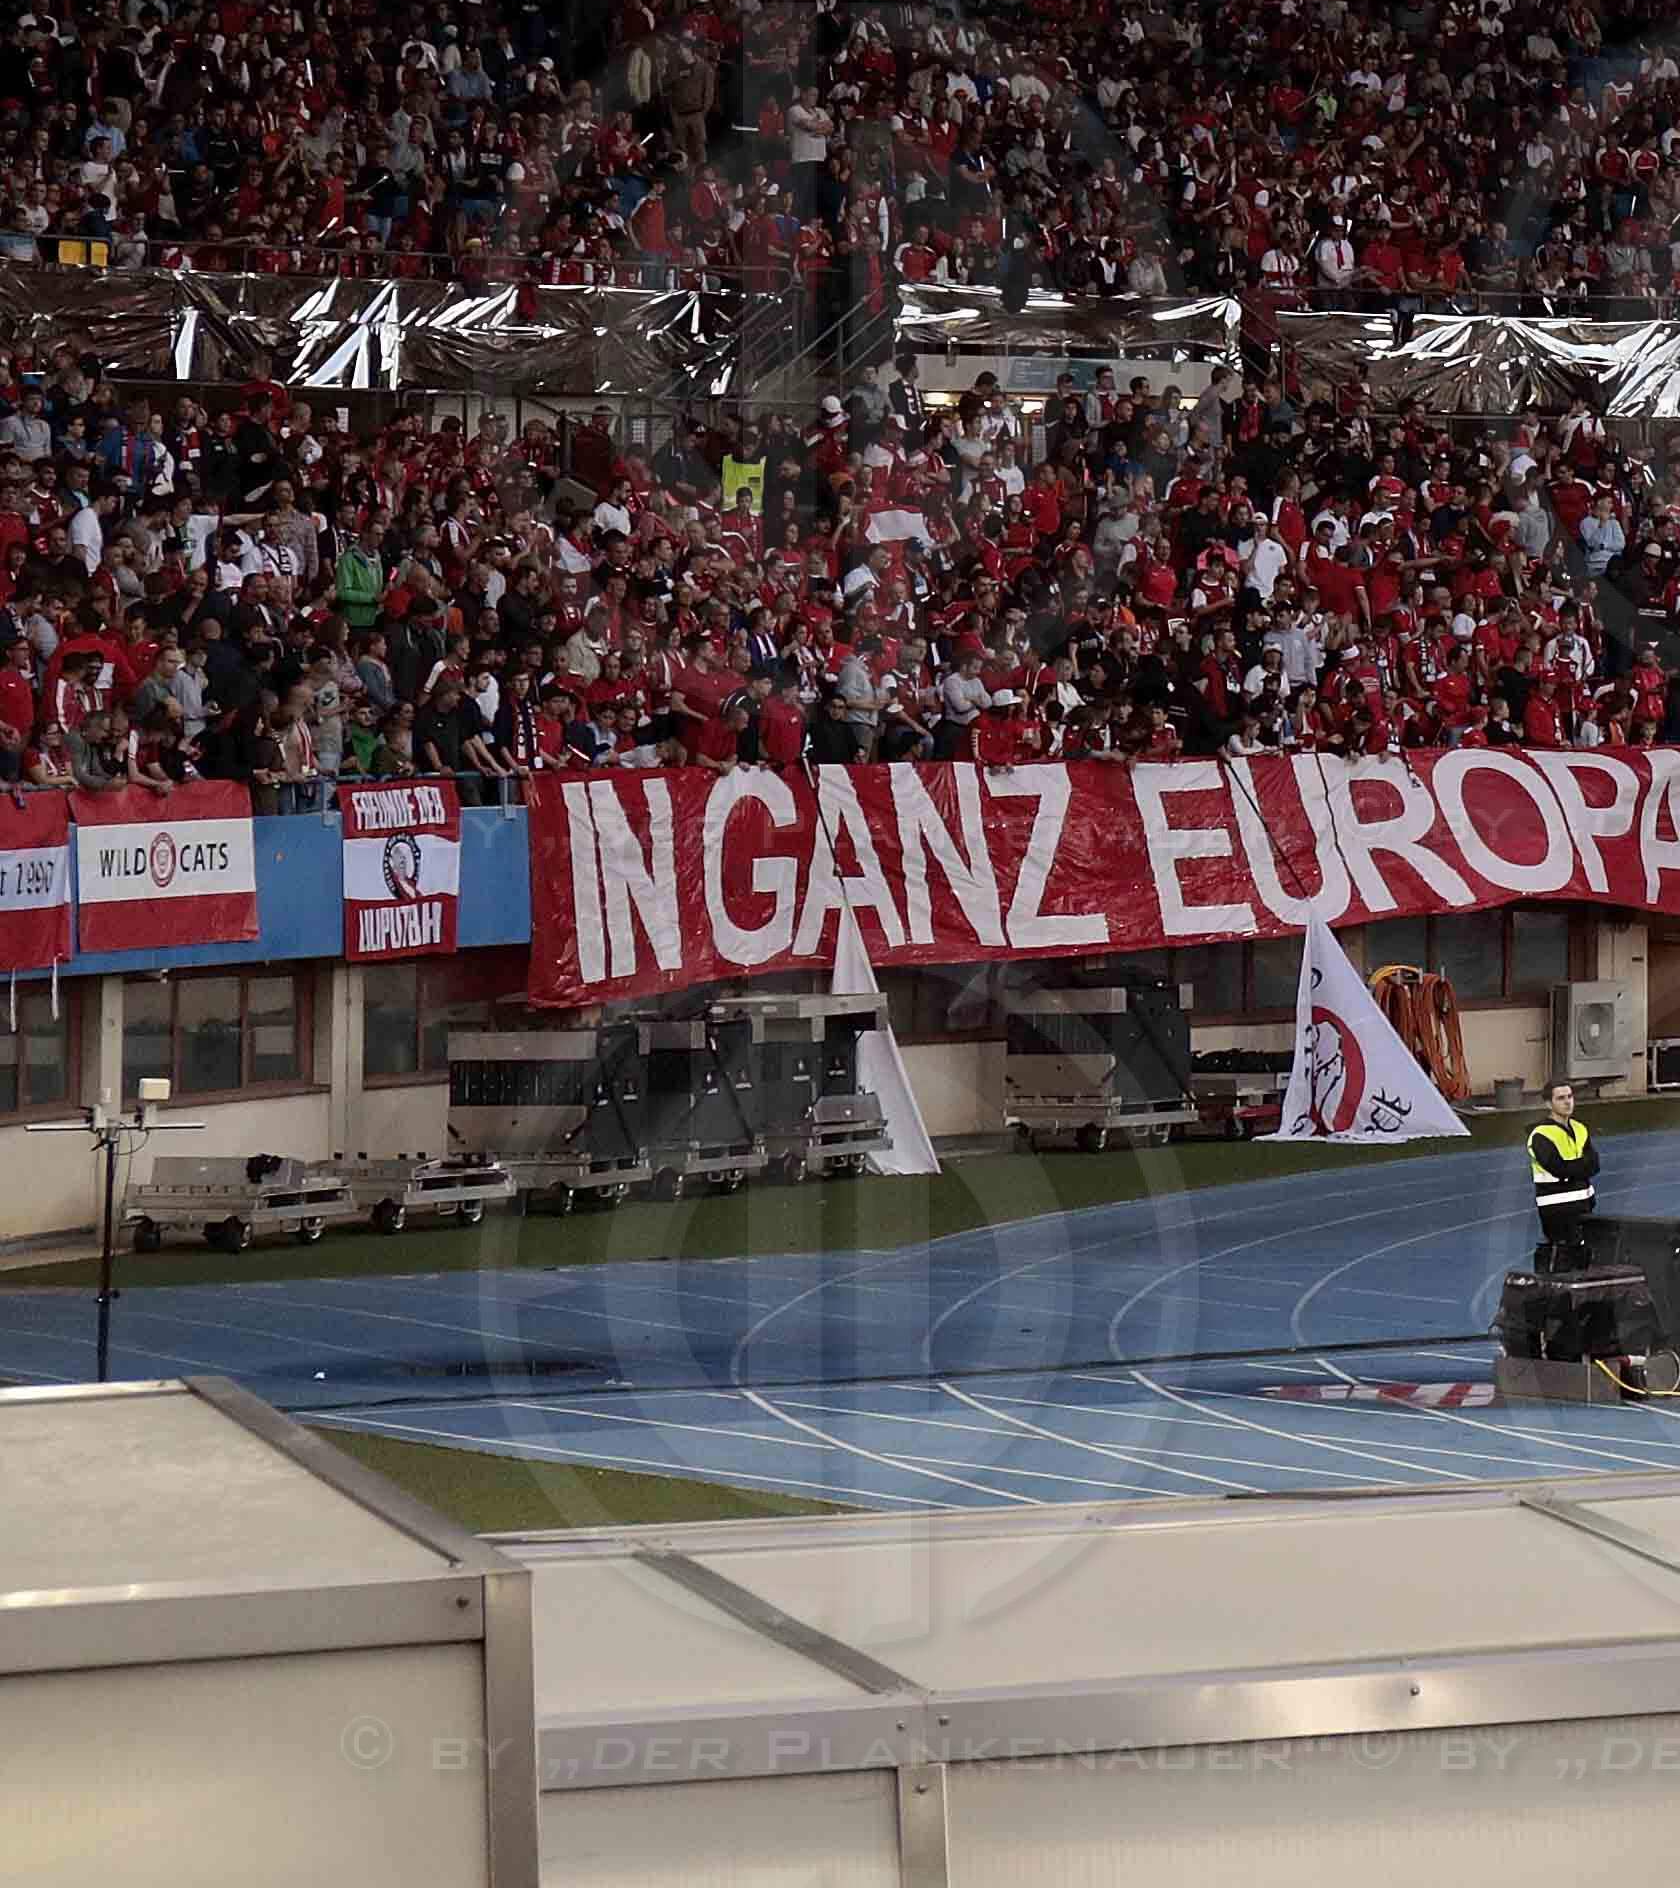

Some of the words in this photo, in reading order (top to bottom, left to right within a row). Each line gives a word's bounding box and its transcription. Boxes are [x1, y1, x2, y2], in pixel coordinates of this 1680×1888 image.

[100, 847, 147, 878] WILD
[180, 842, 229, 873] CATS
[561, 777, 684, 985] IN
[703, 760, 1110, 967] GANZ
